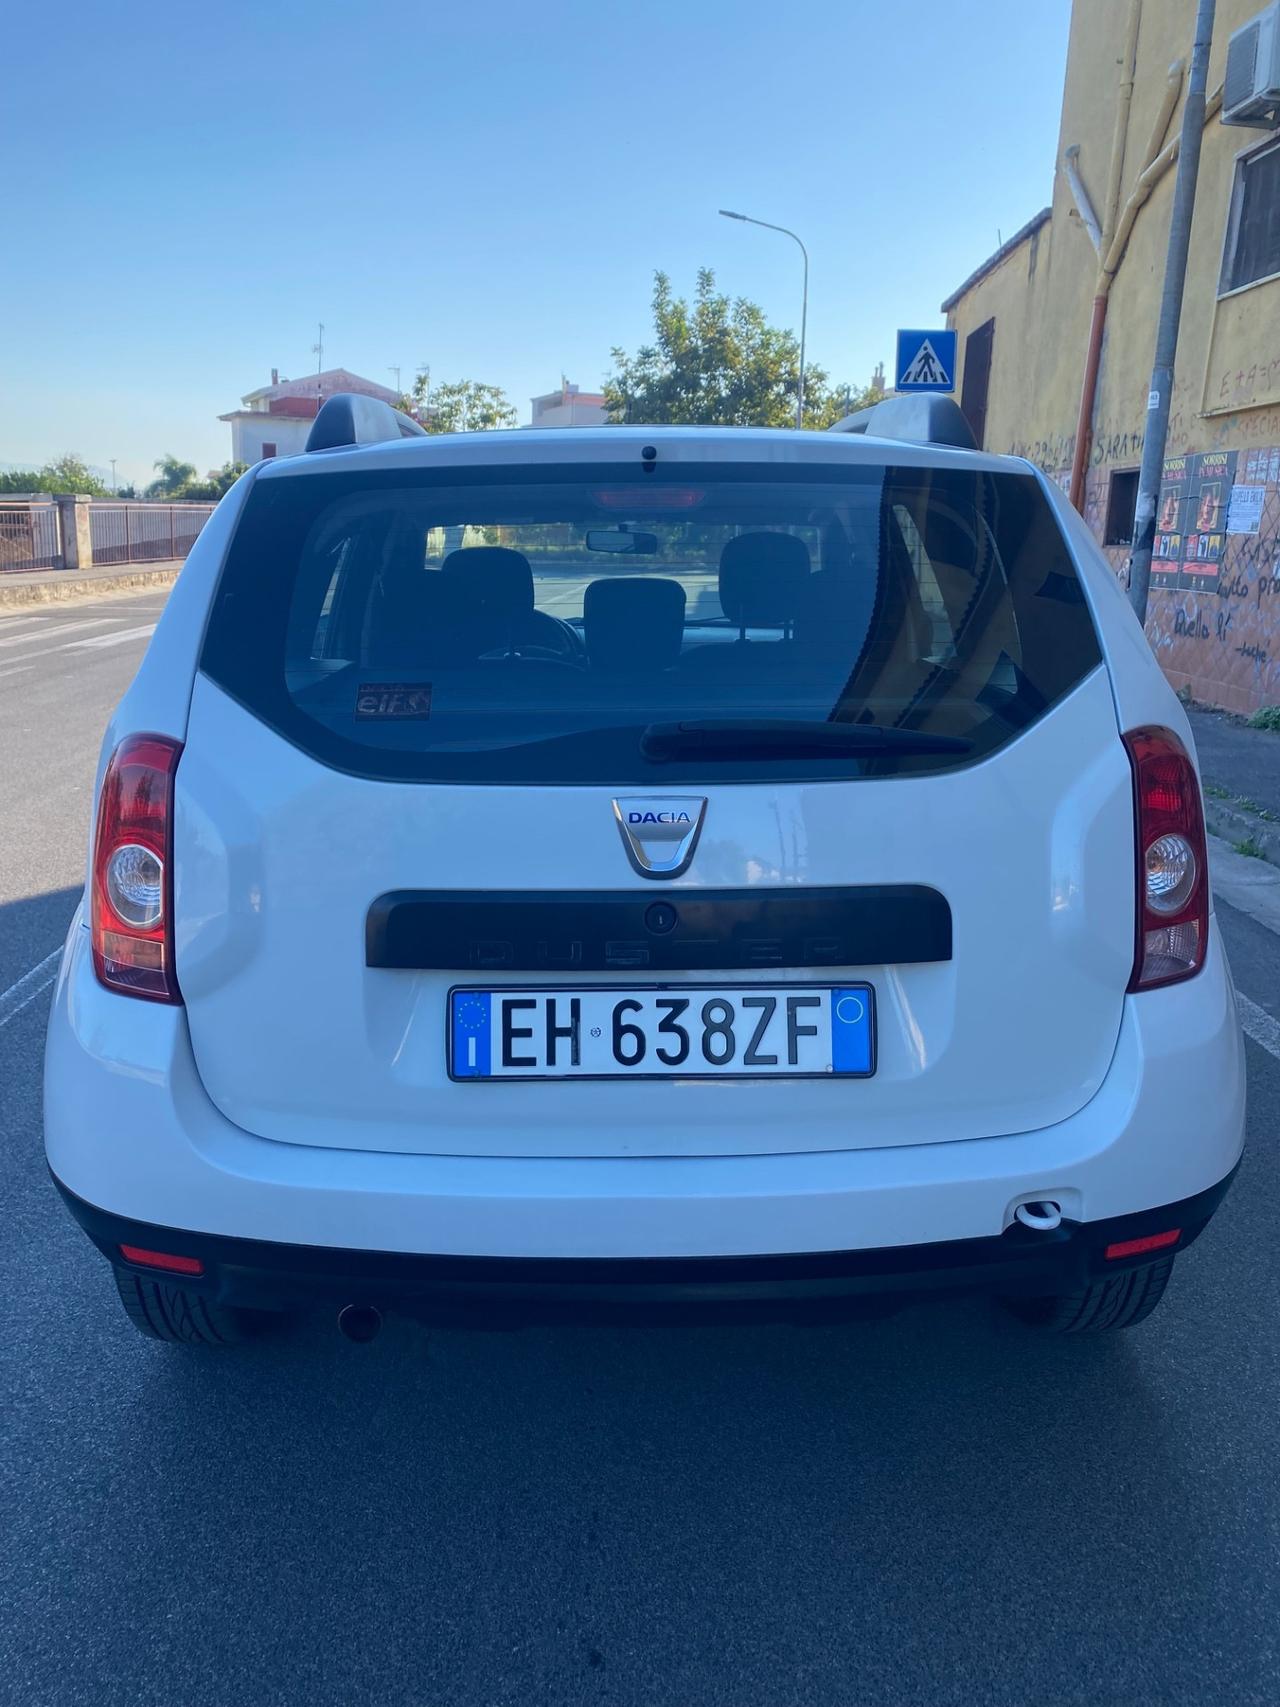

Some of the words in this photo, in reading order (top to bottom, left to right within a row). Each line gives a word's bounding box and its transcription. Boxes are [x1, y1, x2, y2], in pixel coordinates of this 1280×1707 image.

[628, 811, 691, 824] DACIA
[501, 997, 581, 1068] EH
[611, 996, 822, 1067] 638ZF
